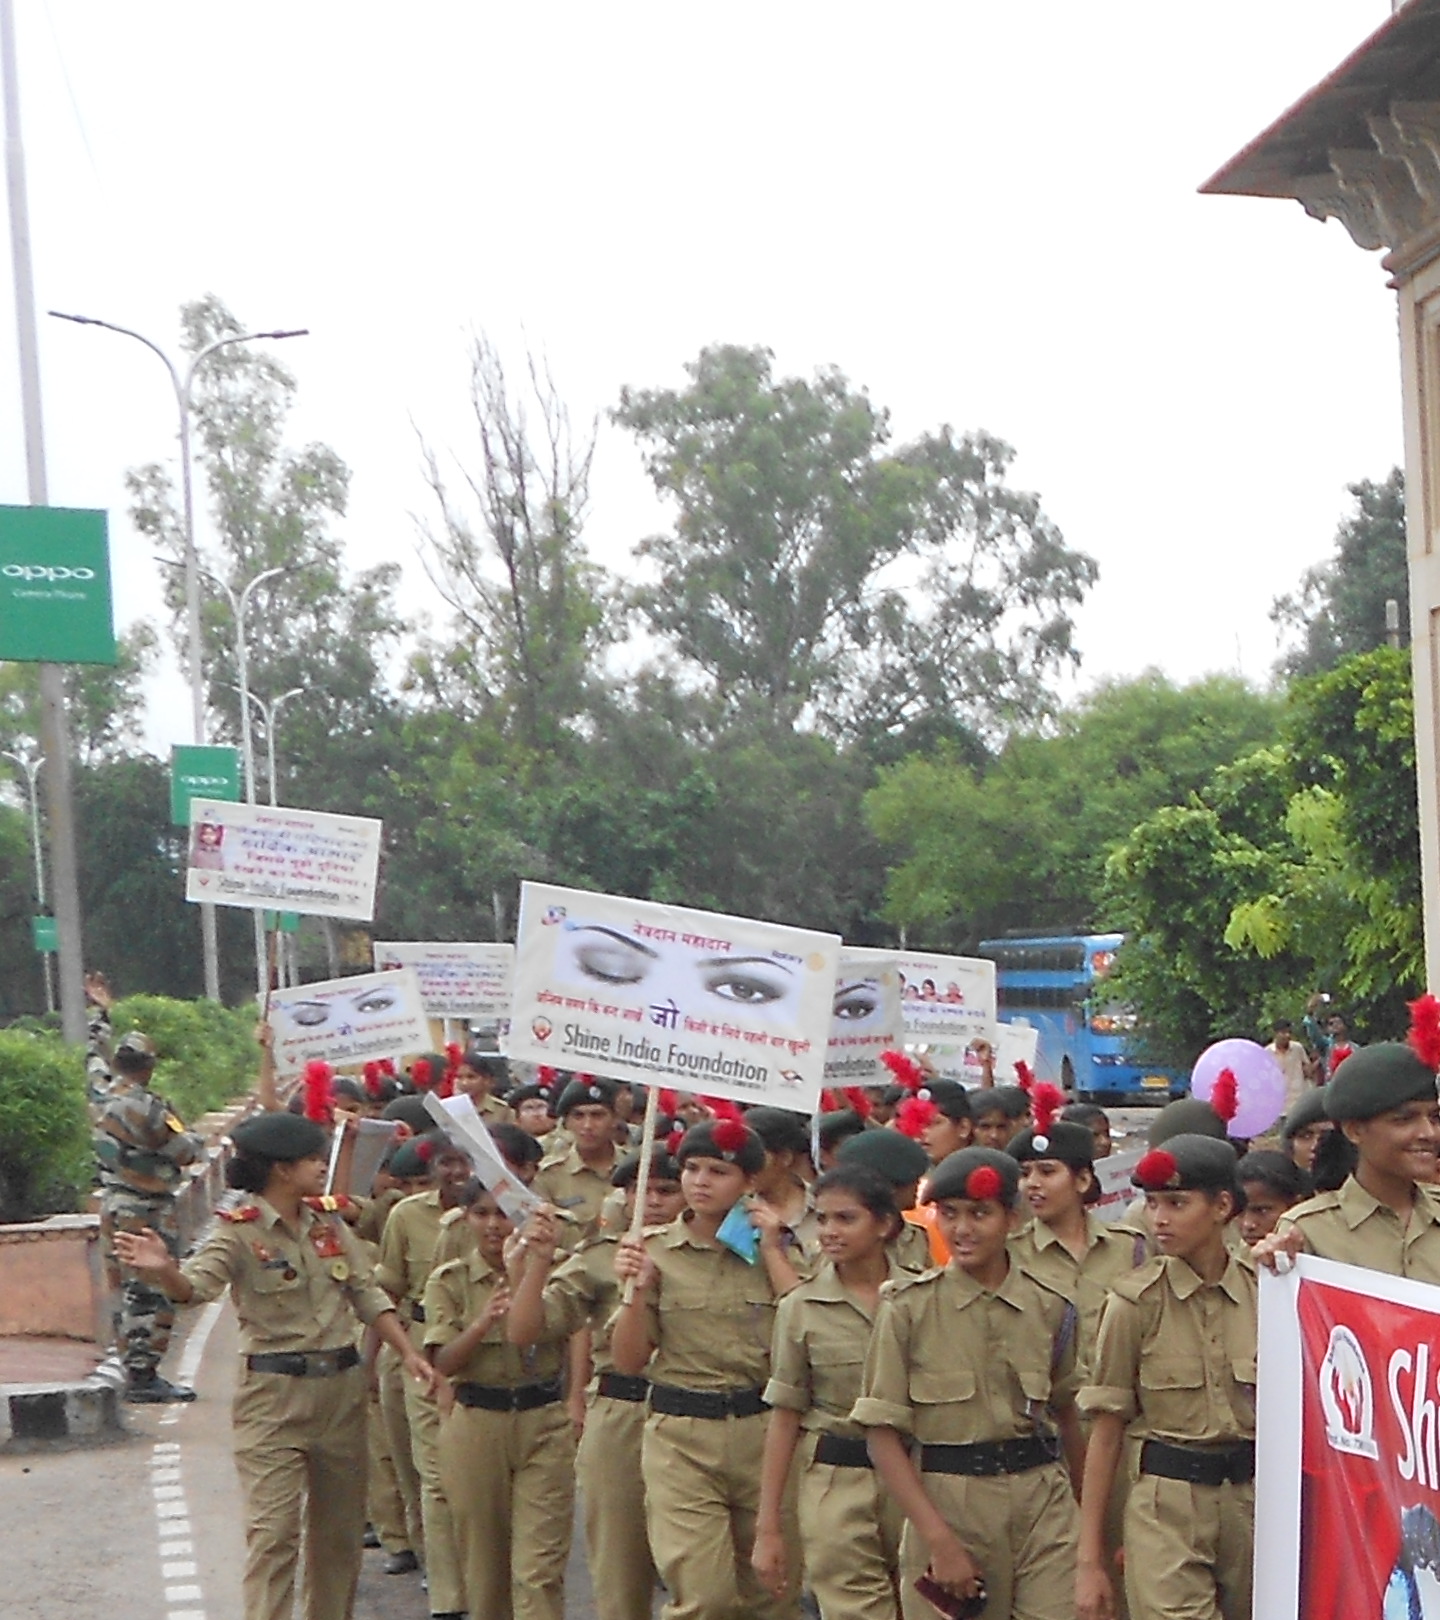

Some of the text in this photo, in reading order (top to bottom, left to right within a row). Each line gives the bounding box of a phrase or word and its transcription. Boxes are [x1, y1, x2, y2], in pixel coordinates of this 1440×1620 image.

[2, 564, 94, 581] oppo
[649, 998, 680, 1030] जो
[563, 1022, 611, 1053] Shine
[616, 1033, 661, 1063] India
[667, 1043, 768, 1083] Foundation
[824, 1055, 876, 1072] oundation
